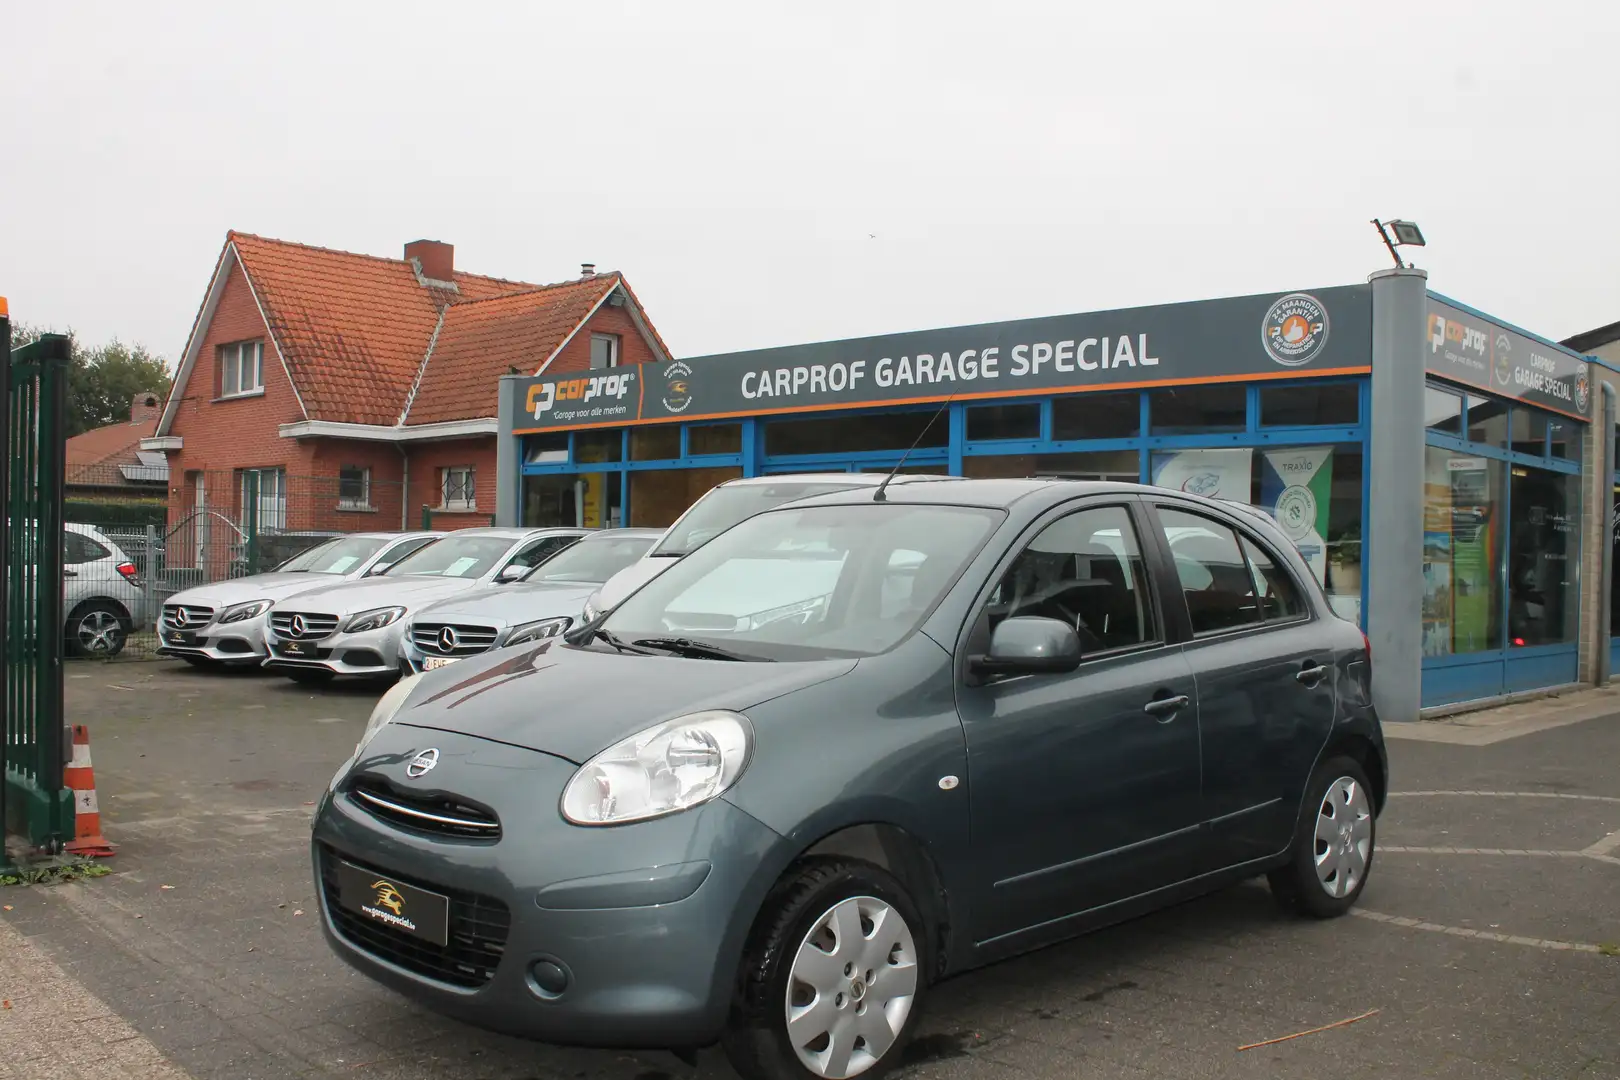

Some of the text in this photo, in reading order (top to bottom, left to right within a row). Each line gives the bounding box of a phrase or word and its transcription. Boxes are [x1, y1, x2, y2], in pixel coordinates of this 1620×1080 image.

[1272, 300, 1320, 320] 24 MAANDEN
[1278, 308, 1314, 324] GARANTIE
[741, 334, 1159, 399] CARPROF GARAGE SPECIAL
[1530, 353, 1556, 372] CARPROF
[1514, 366, 1544, 391] GARAGE
[1544, 376, 1572, 400] SPECIAL
[576, 409, 590, 418] voor
[590, 407, 602, 416] alle
[603, 404, 626, 414] merken
[1282, 462, 1312, 472] TRAXIO
